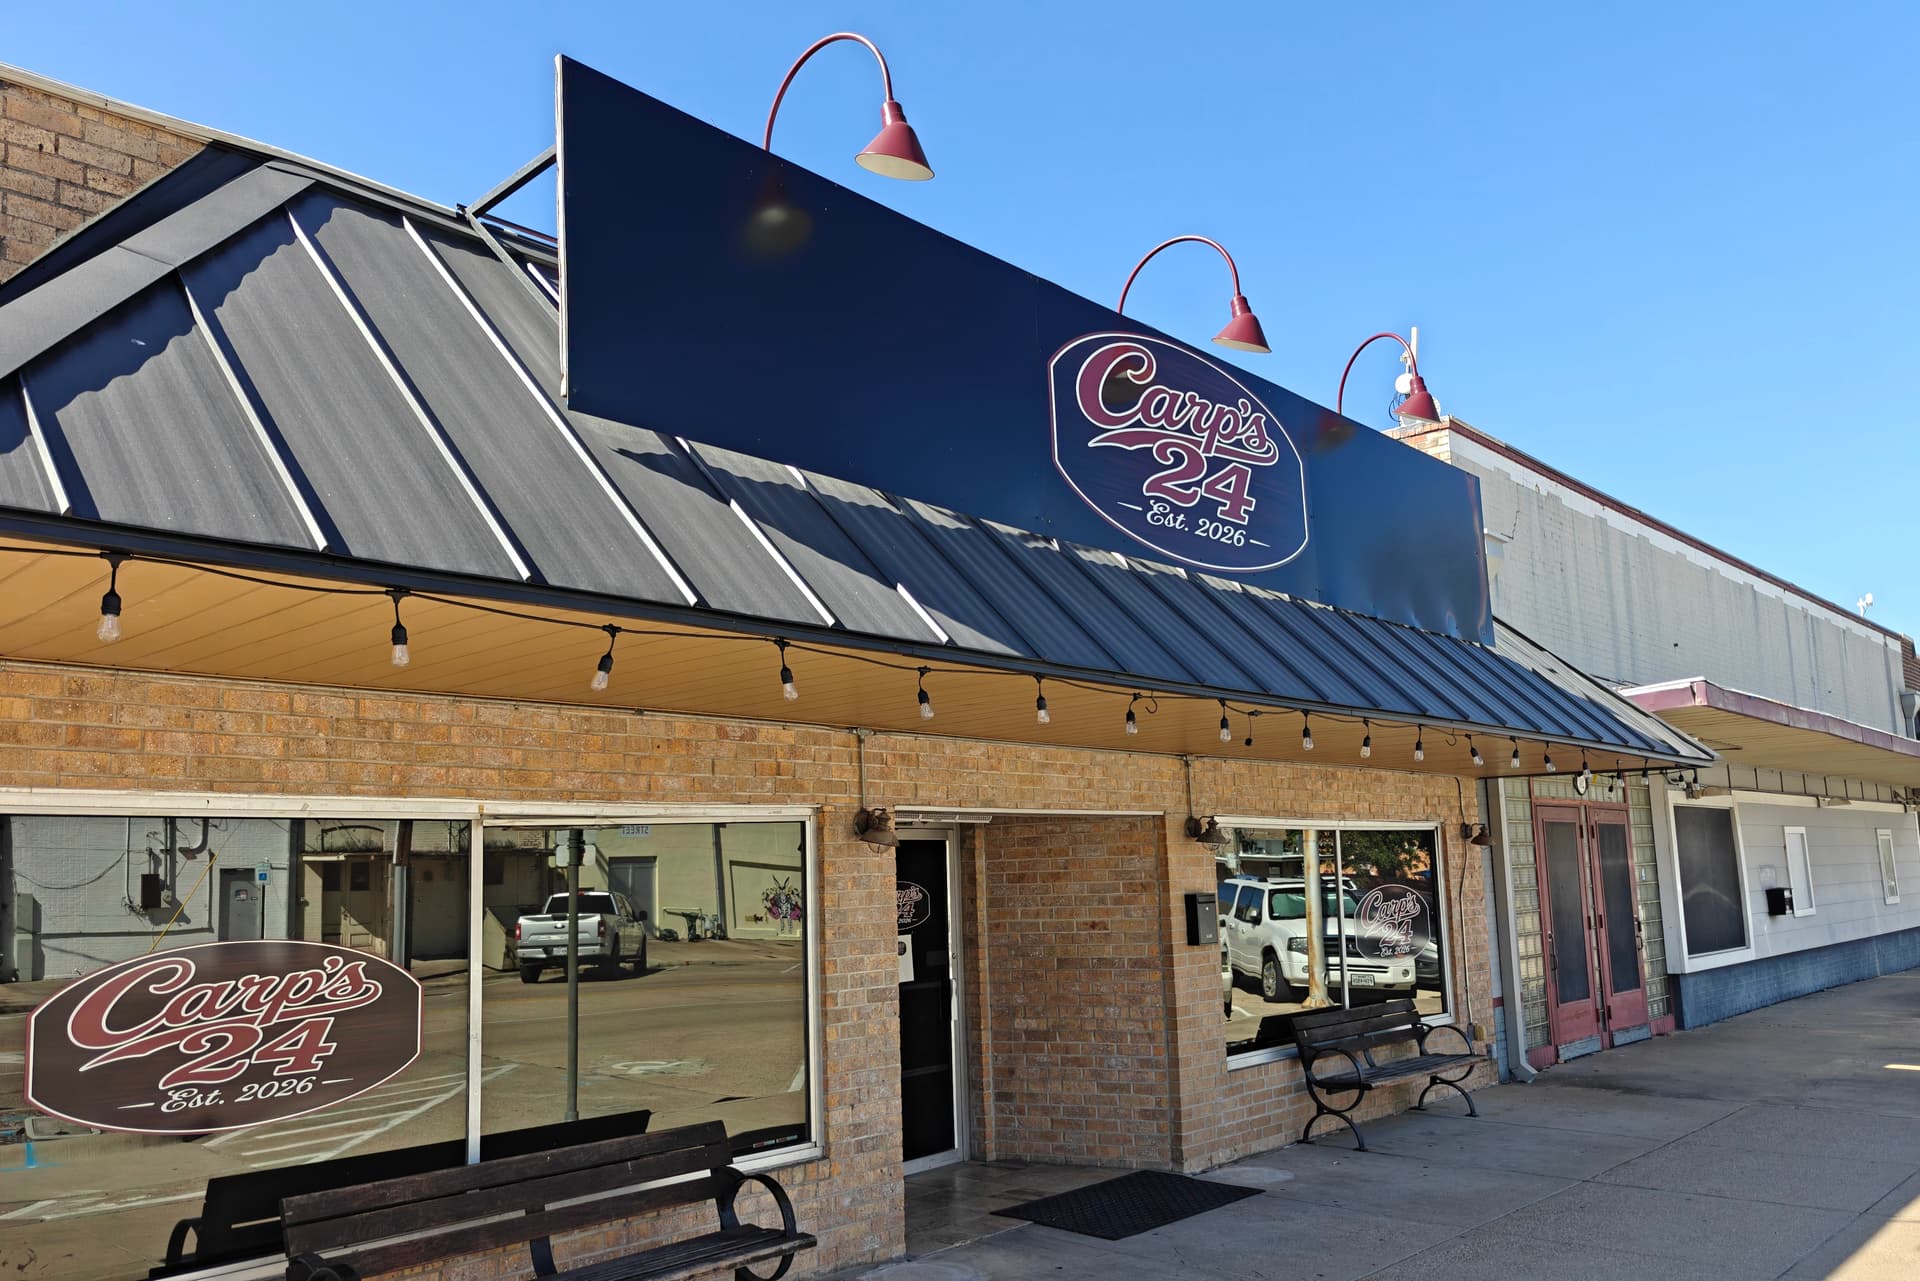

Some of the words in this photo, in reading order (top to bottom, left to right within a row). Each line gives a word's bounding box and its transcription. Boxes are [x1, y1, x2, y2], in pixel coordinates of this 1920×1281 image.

[1076, 342, 1278, 460] Carp's
[1143, 439, 1256, 525] 24
[1146, 500, 1189, 532] Est.
[1194, 518, 1246, 547] 2026
[1361, 890, 1420, 930] Carp's
[1379, 919, 1413, 947] 24
[67, 956, 382, 1049] Carp's
[158, 1017, 338, 1090] 24
[160, 1088, 226, 1113] Est.
[234, 1077, 316, 1103] 2026
